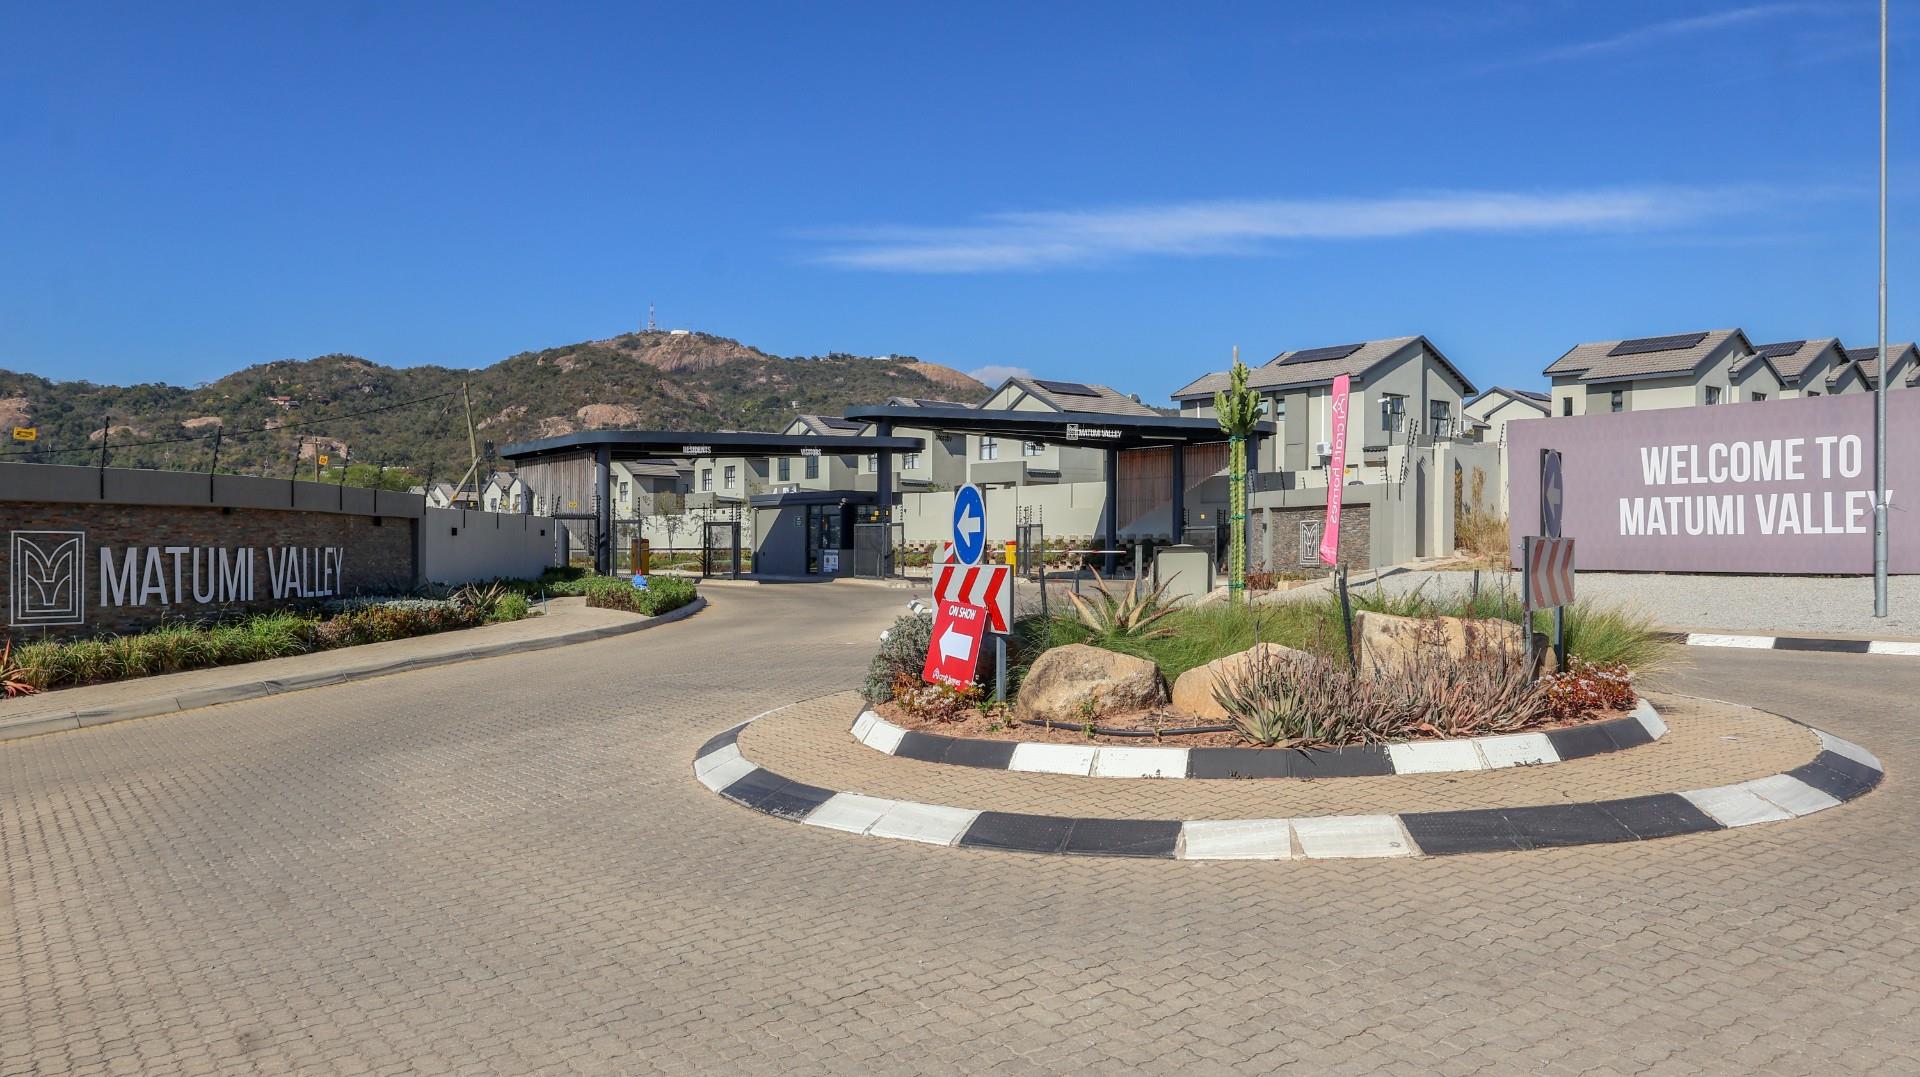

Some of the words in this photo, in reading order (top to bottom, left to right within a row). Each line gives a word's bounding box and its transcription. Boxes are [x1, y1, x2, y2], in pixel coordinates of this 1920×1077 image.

[683, 446, 711, 454] RESIDENTS
[800, 448, 821, 456] VISITORS
[1640, 438, 1805, 485] WELCOME
[1815, 434, 1862, 479] TO
[1619, 494, 1745, 536] MATUMI
[100, 546, 254, 607] MATUMI
[267, 546, 344, 600] VALLEY
[948, 605, 958, 617] ON
[958, 607, 977, 620] SHOW
